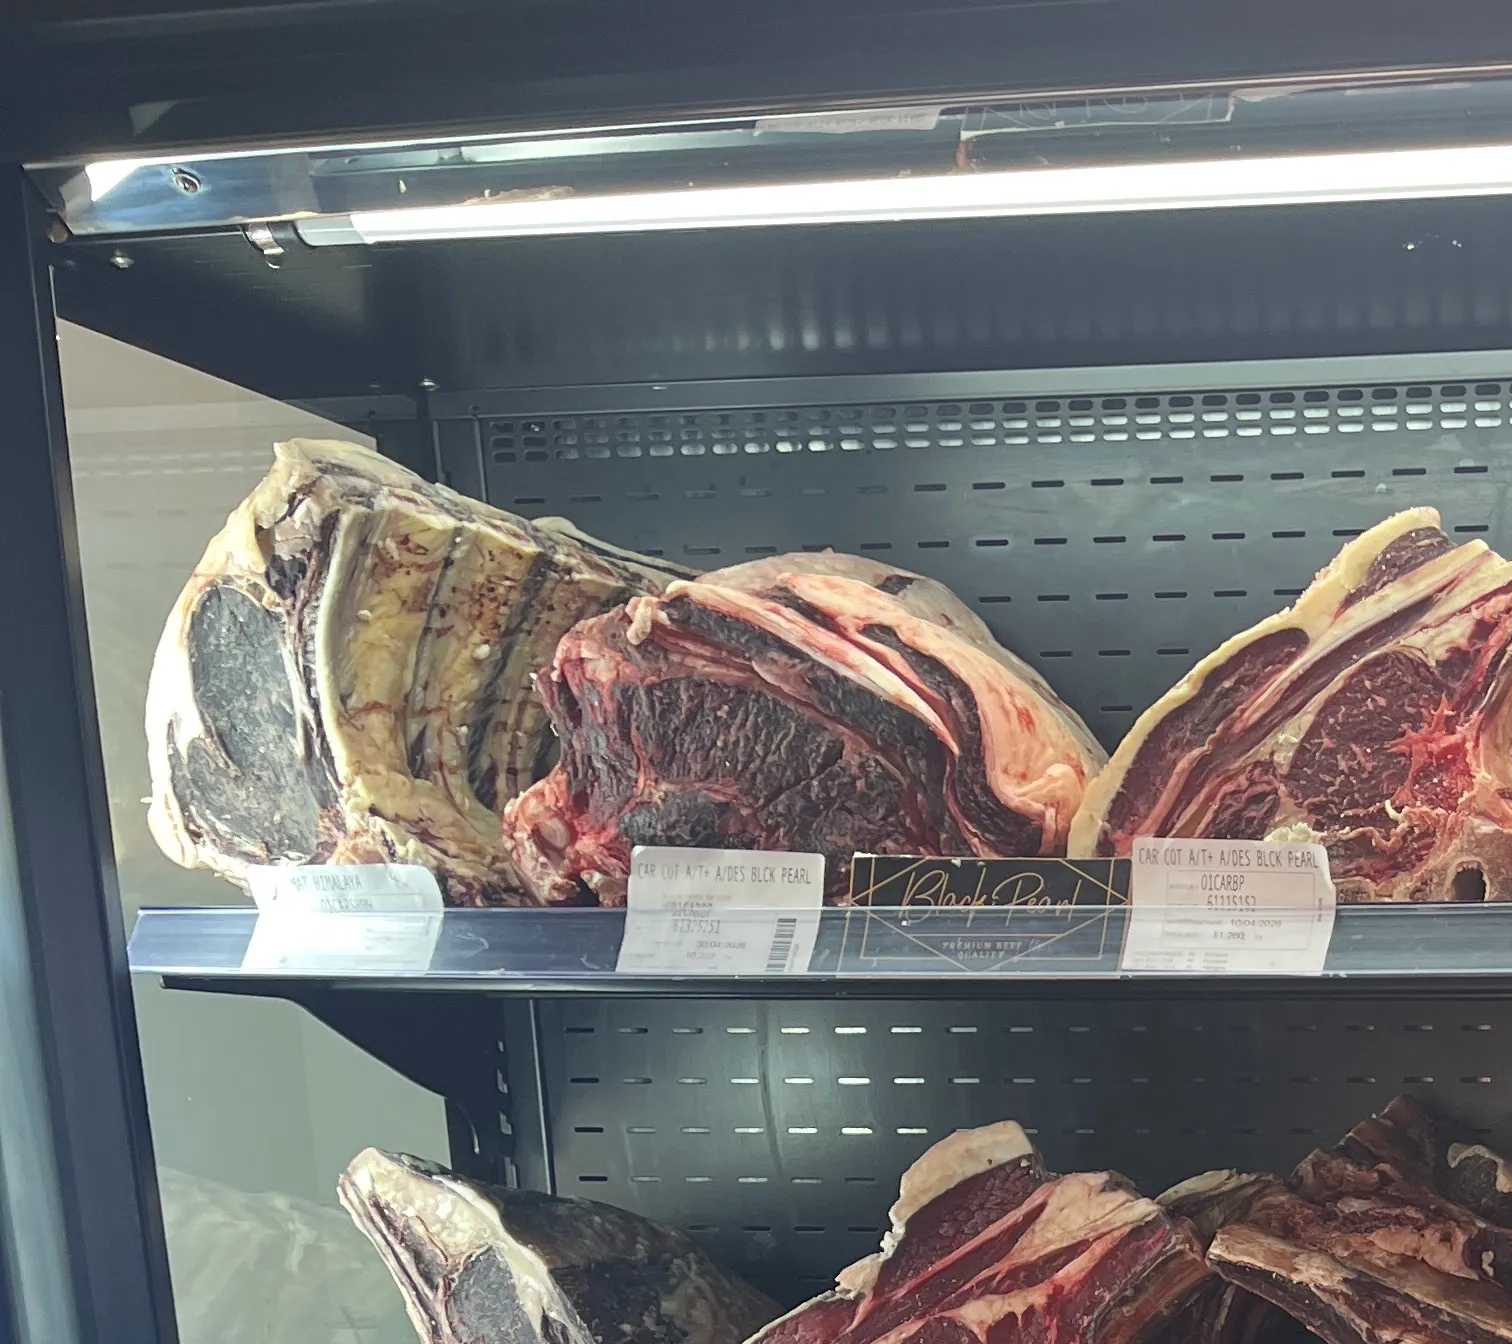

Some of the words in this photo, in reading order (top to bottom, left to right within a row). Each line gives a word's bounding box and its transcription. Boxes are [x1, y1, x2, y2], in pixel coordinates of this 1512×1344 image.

[1138, 847, 1158, 865] CAR
[1164, 848, 1183, 866] COT
[1219, 849, 1251, 868] A/DES
[1257, 849, 1283, 868] BLCK
[1287, 851, 1319, 869] PEARL
[312, 873, 364, 892] HIMALAYA
[636, 862, 656, 880] CAR
[750, 866, 776, 884] BLCK
[781, 867, 812, 885] PEARL
[899, 867, 988, 928] Black
[991, 872, 1083, 927] Pearl
